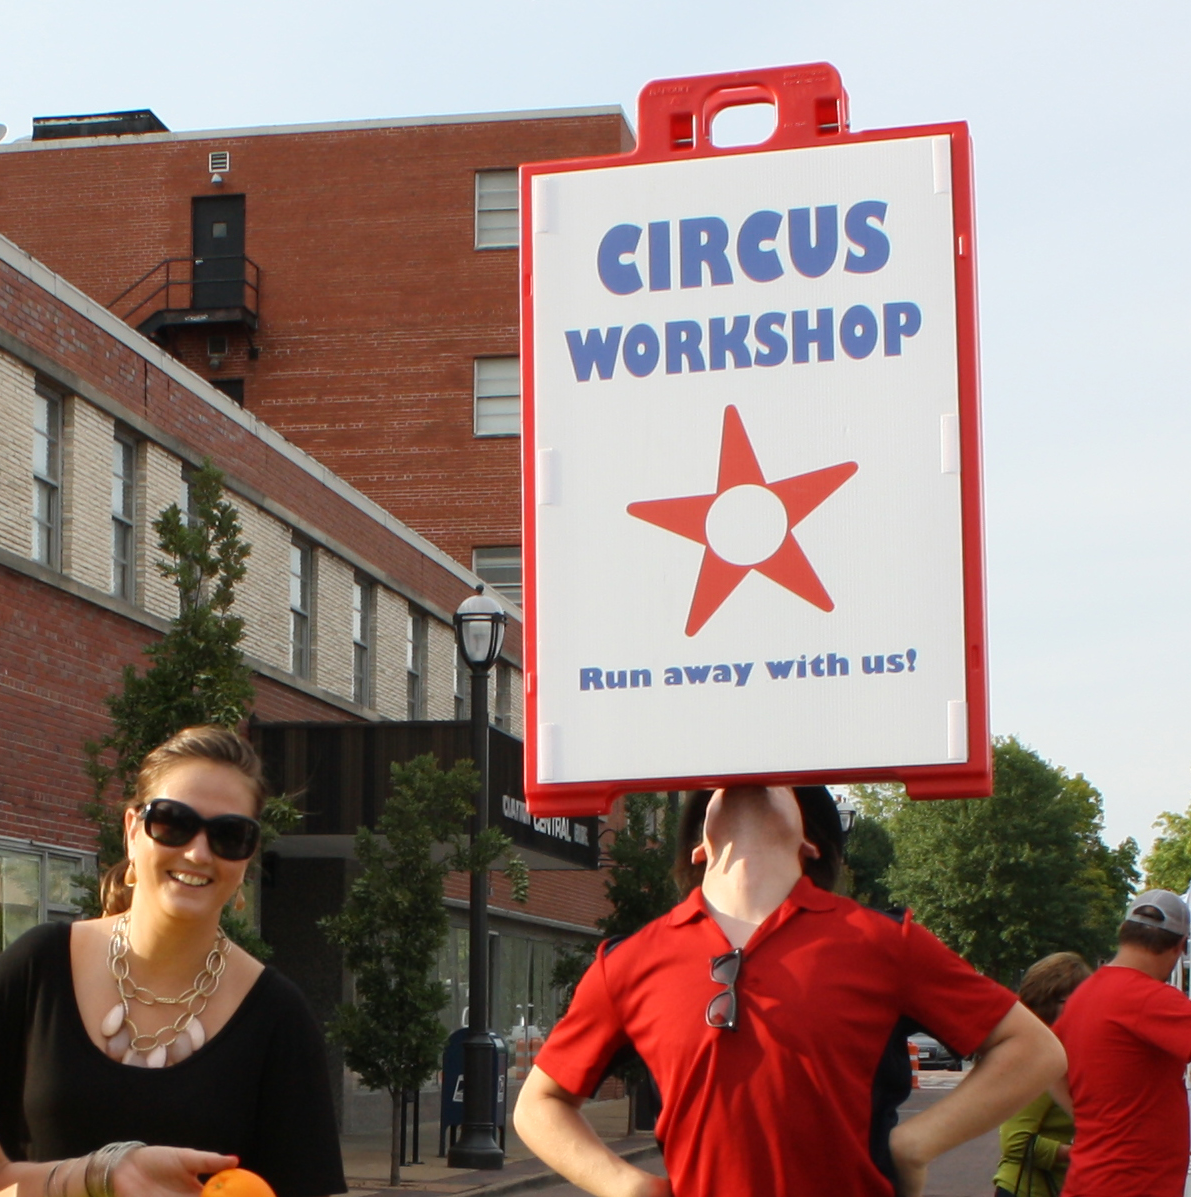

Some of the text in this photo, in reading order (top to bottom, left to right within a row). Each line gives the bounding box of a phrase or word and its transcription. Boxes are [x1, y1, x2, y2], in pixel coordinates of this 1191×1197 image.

[596, 200, 890, 296] CIRCUS
[564, 301, 922, 383] WORKSHOP
[579, 648, 918, 691] Run away with us!
